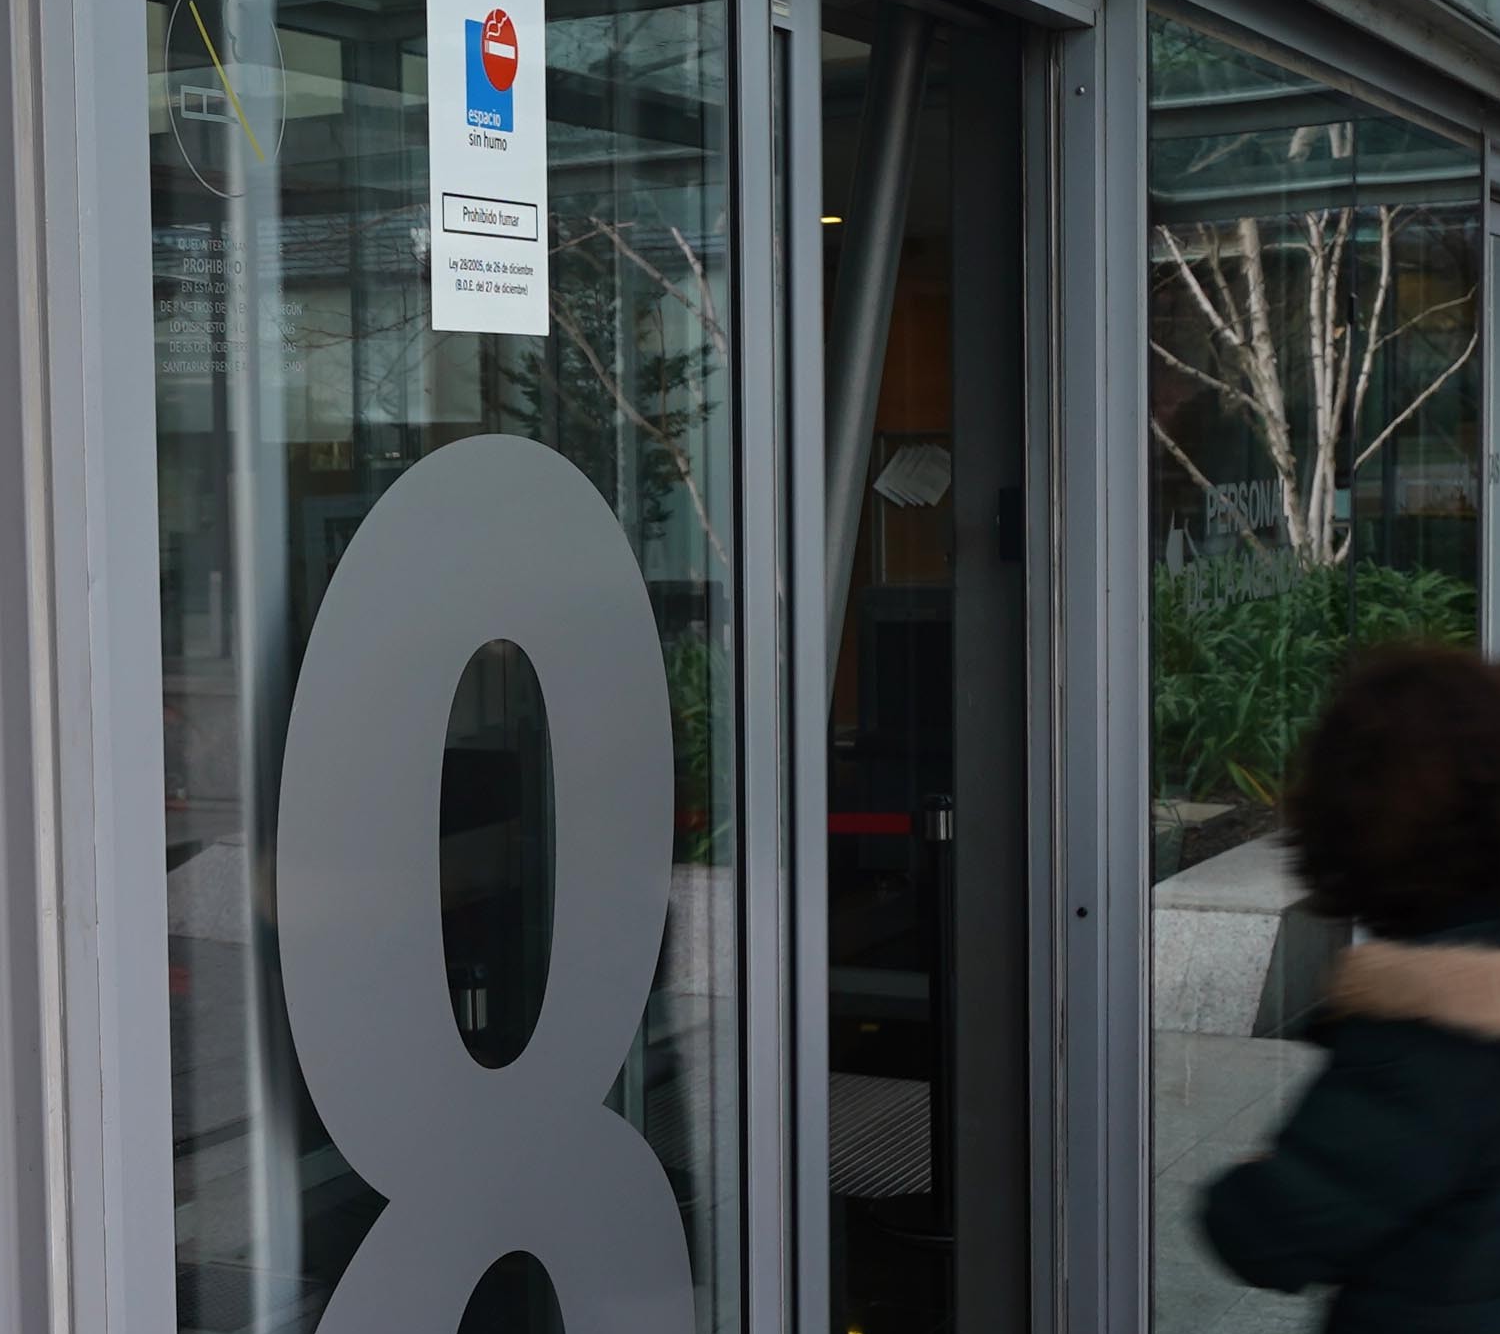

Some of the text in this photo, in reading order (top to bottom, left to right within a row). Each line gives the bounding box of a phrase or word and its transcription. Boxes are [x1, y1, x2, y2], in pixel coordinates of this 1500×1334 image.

[469, 109, 501, 127] espacio
[469, 129, 507, 151] sin humo
[463, 206, 520, 227] Prohibido fumar
[449, 257, 458, 273] Ley
[485, 261, 492, 272] de
[493, 261, 501, 273] 26
[502, 262, 508, 274] de
[509, 263, 534, 275] diciembre
[476, 280, 484, 292] del
[485, 281, 493, 293] 27
[494, 282, 501, 293] de
[502, 283, 528, 295] diciembre)
[1207, 479, 1289, 536] PERSONAL
